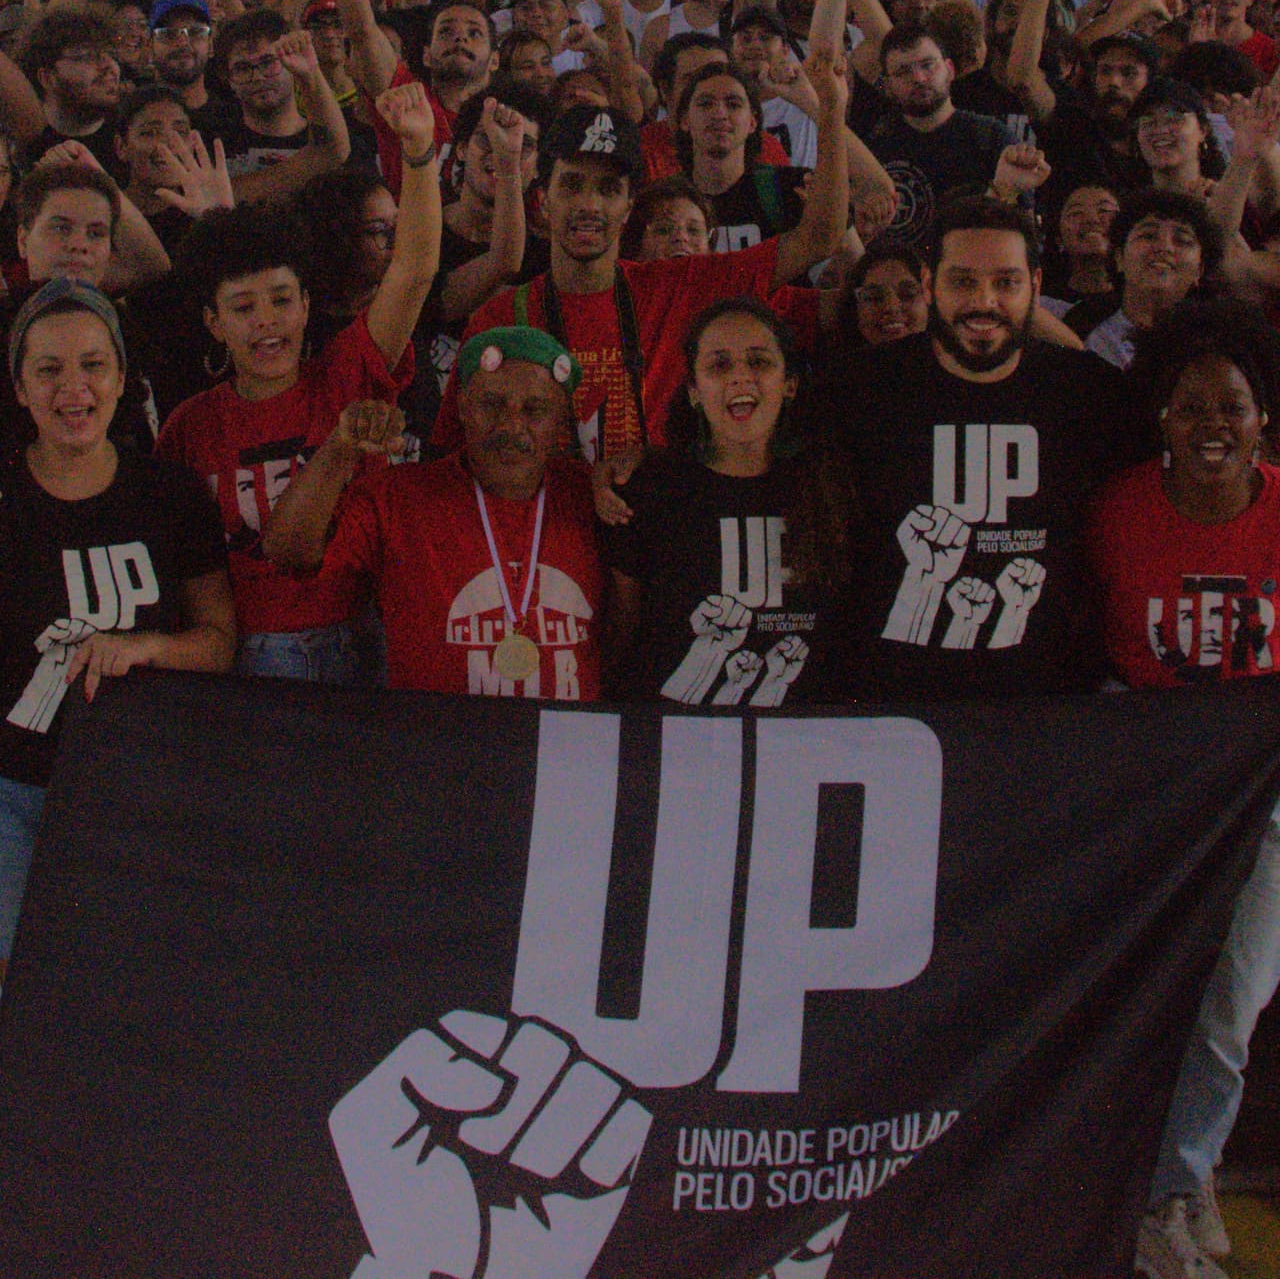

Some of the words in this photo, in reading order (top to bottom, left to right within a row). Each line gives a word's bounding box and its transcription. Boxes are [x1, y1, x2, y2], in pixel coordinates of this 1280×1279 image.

[933, 424, 1039, 523] UP
[977, 530, 1011, 541] UNIDADE
[977, 540, 998, 553] PELO
[62, 541, 160, 630] UP
[510, 710, 943, 1093] UP
[677, 1127, 816, 1168] UNIDADE
[672, 1170, 756, 1211] PELO
